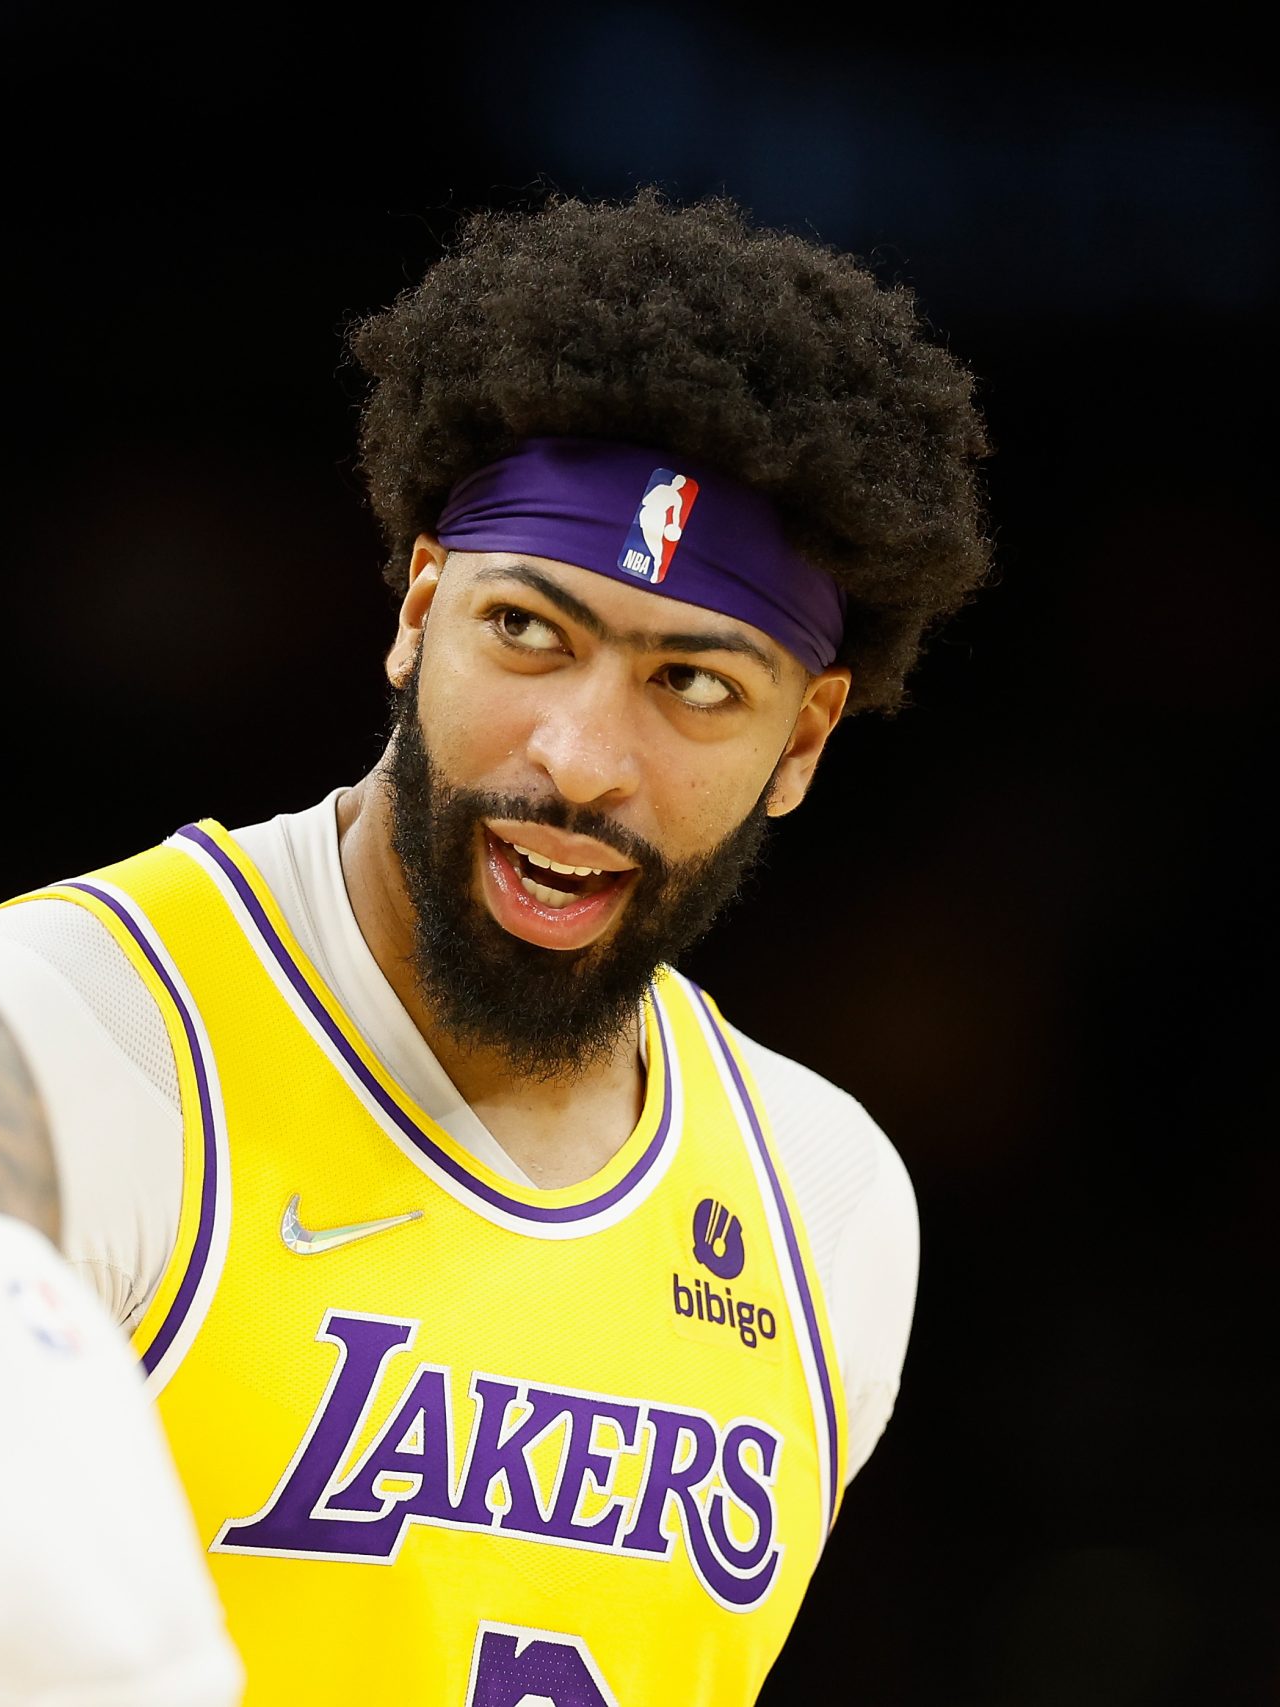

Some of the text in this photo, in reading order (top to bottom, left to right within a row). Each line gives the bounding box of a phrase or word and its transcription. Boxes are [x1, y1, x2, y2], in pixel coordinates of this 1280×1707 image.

[623, 550, 651, 574] NBA
[673, 1273, 776, 1348] bibigo
[212, 1310, 783, 1611] LAKERS
